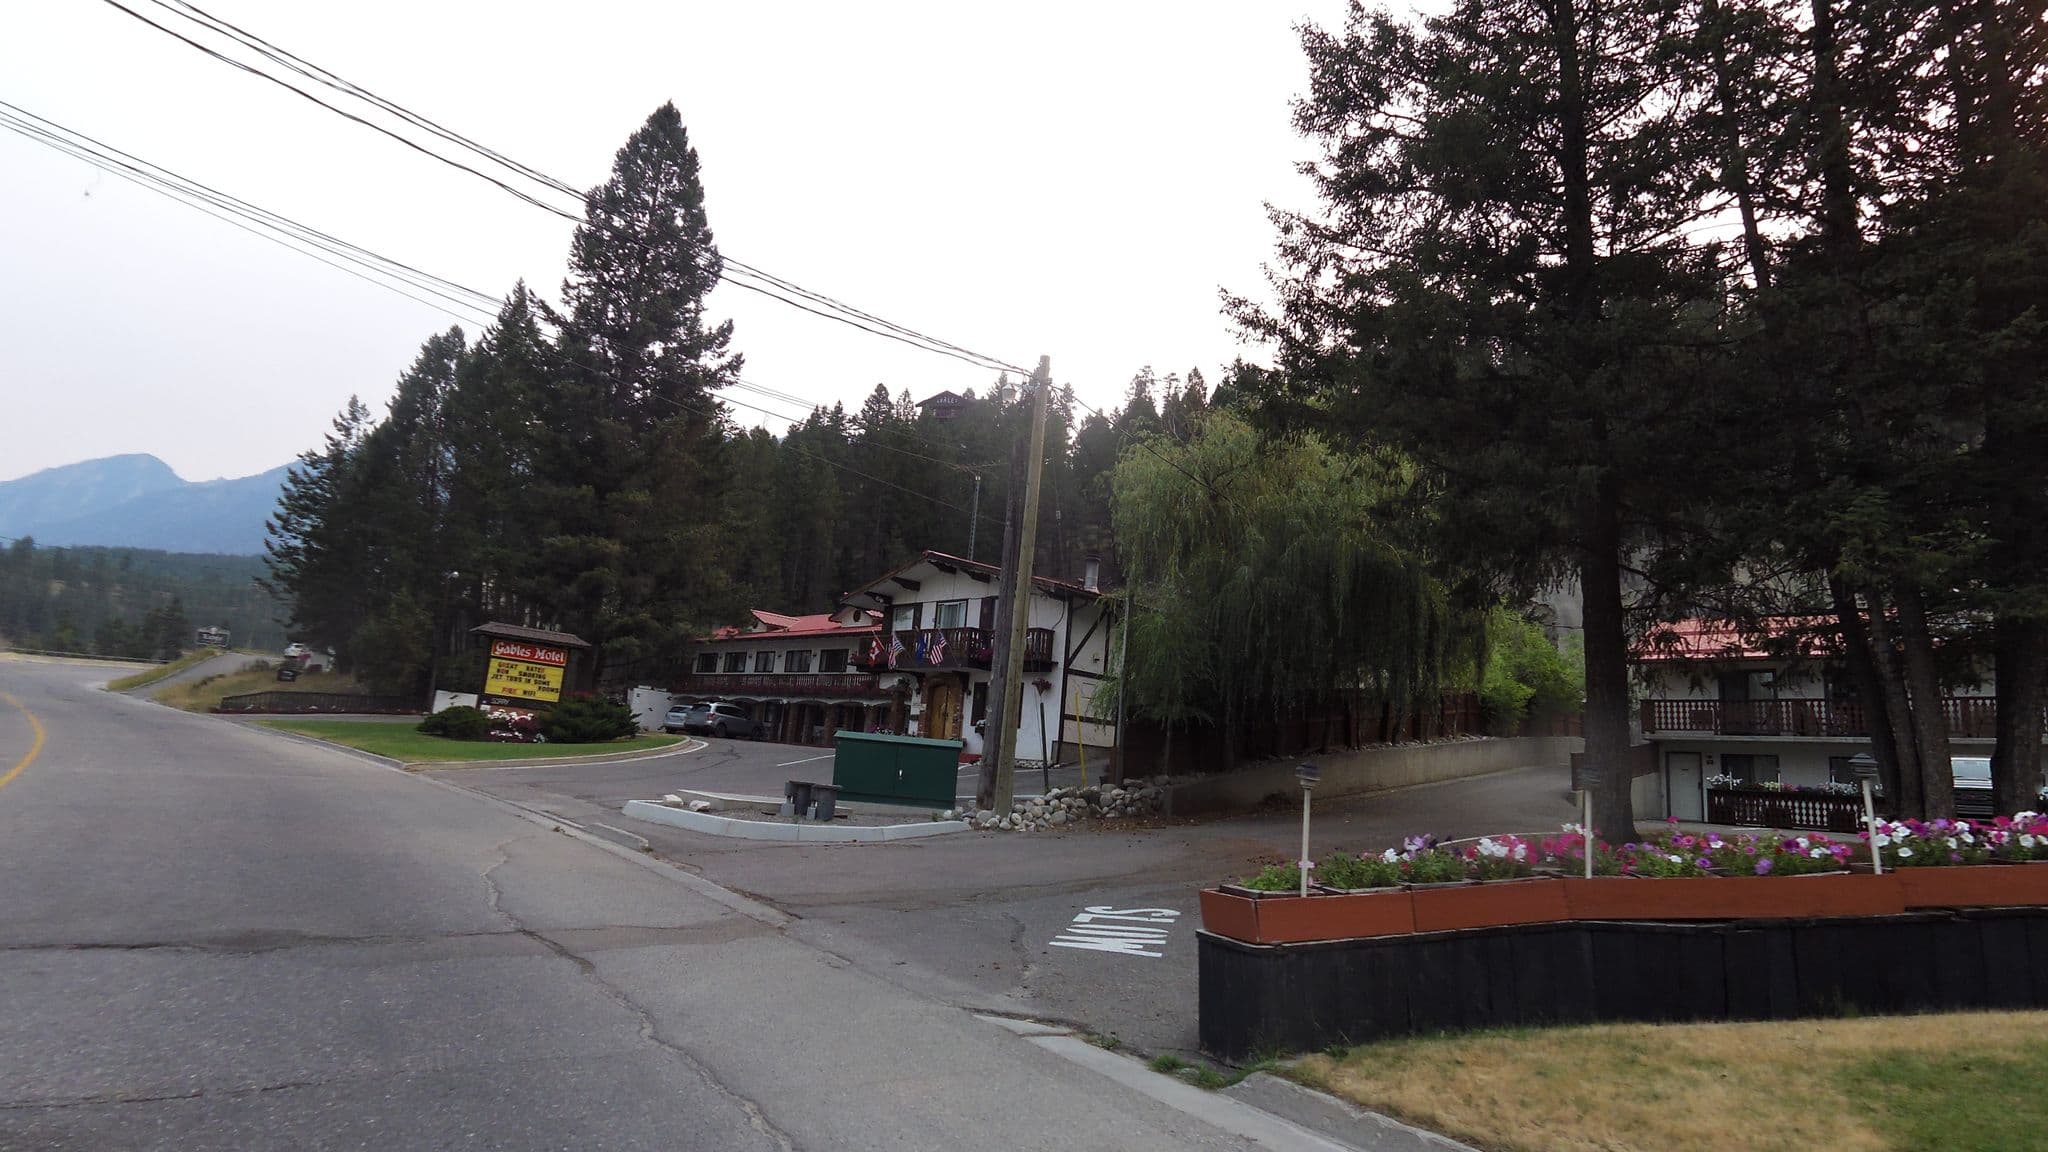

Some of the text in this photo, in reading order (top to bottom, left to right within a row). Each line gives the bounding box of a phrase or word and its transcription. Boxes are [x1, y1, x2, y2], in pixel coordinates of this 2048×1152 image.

[496, 642, 564, 662] Gables Motel
[497, 662, 518, 670] GREAT
[506, 675, 522, 683] TUBS
[518, 671, 546, 679] SMOKING
[1048, 906, 1181, 957] SLOW
